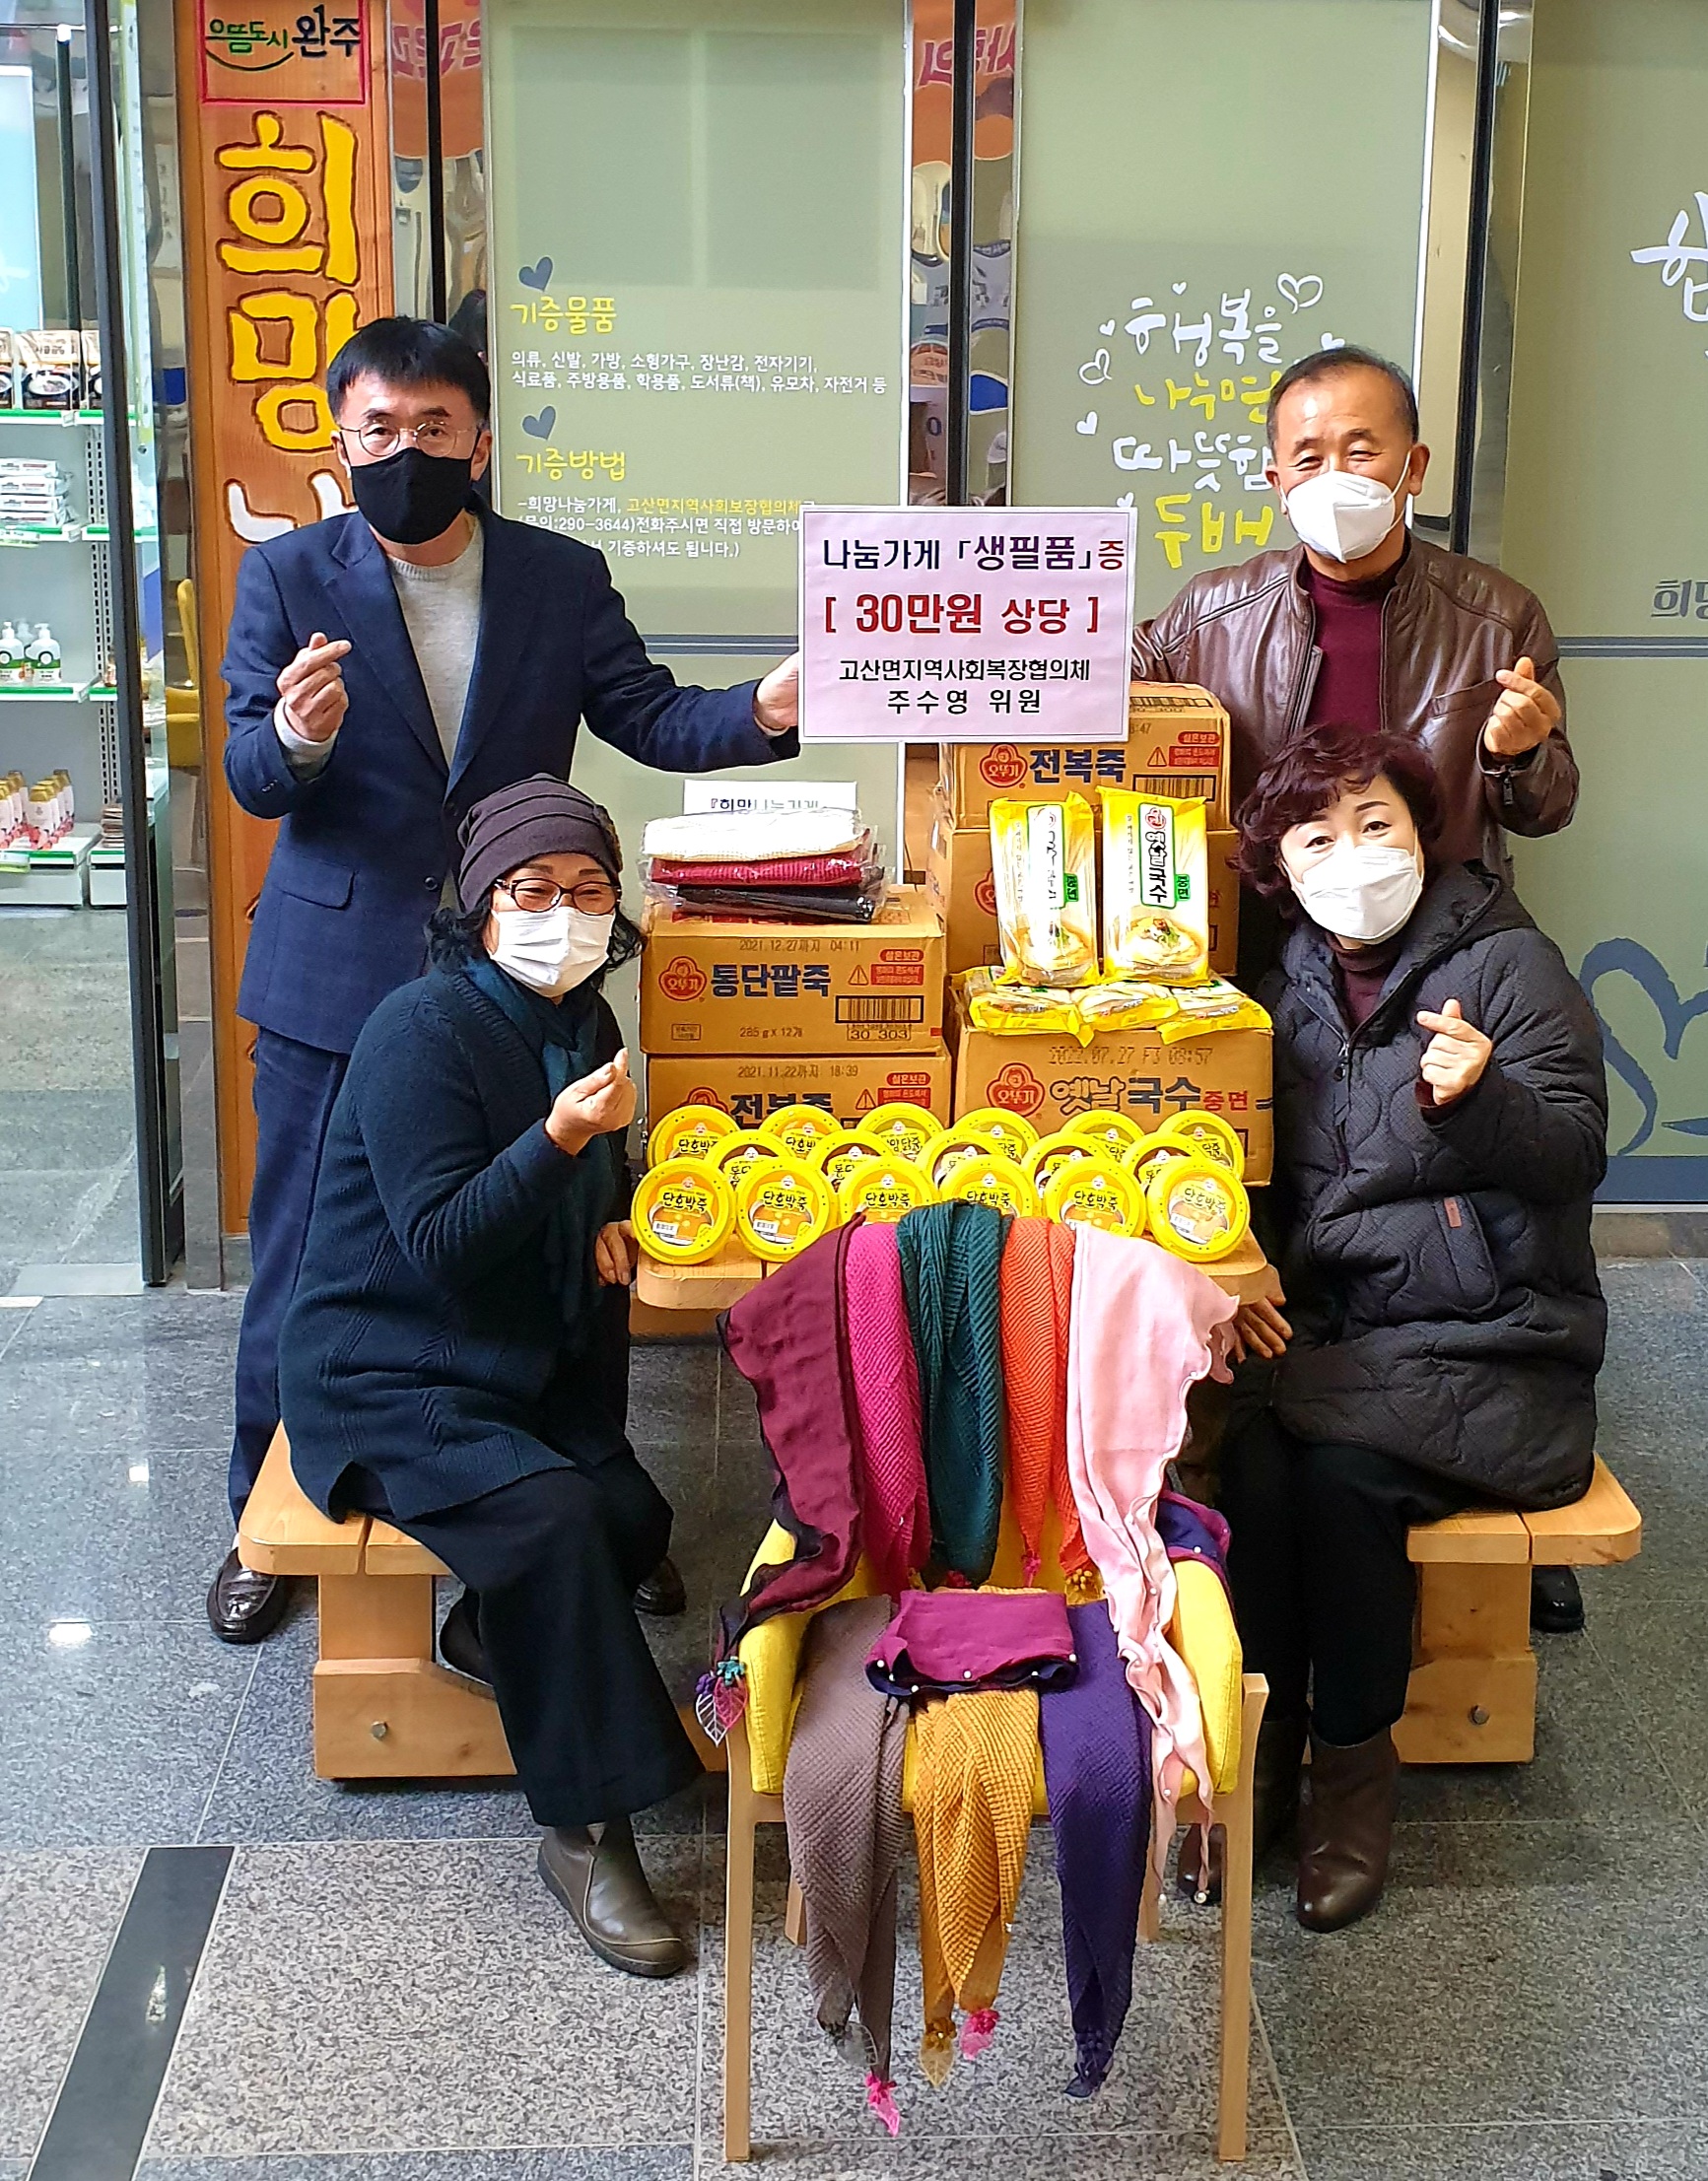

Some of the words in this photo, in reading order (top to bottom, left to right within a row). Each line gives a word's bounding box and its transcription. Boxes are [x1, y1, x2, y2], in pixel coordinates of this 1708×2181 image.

[205, 18, 289, 54] 으뜸도시
[292, 4, 361, 58] 완주
[510, 295, 618, 335] 기증물품
[1124, 287, 1283, 369] 행복을
[512, 350, 547, 369] 의류,
[551, 351, 587, 370] 신발,
[591, 352, 627, 371] 가방,
[631, 353, 696, 372] 소형가구,
[700, 354, 750, 373] 장난감,
[754, 355, 819, 374] 전자기기,
[512, 371, 563, 389] 식료품,
[567, 372, 632, 391] 주방용품,
[636, 373, 687, 391] 학용품,
[690, 375, 767, 392] 도서류(책),
[770, 375, 821, 393] 유모차,
[824, 376, 868, 394] 자전거
[871, 377, 888, 394] 등
[515, 446, 628, 482] 기증방법
[626, 499, 815, 515] 고산면지역사회보장협의체
[714, 519, 742, 535] 직접
[1154, 493, 1274, 570] 두배
[607, 540, 681, 558] 기증하셔도
[685, 541, 741, 559] 됩니다.)
[823, 539, 940, 570] 나눔가게
[855, 592, 982, 634] 30만원
[1000, 597, 1069, 635] 상당
[839, 658, 1090, 681] 고산면지역사회복장협의체
[989, 689, 1041, 714] 위원
[989, 764, 1020, 778] 오뚜기
[1030, 748, 1127, 784] 전복죽
[711, 964, 831, 997] 통단팥죽
[997, 1089, 1035, 1104] 오뚜기
[1202, 1090, 1249, 1111] 중면
[662, 1191, 709, 1211] 단호박죽
[763, 1190, 809, 1211] 단호박죽
[865, 1192, 912, 1208] 단호박죽
[966, 1190, 1012, 1208] 단호박죽
[1073, 1190, 1119, 1211] 단호박죽
[1184, 1187, 1228, 1214] 단호박죽
